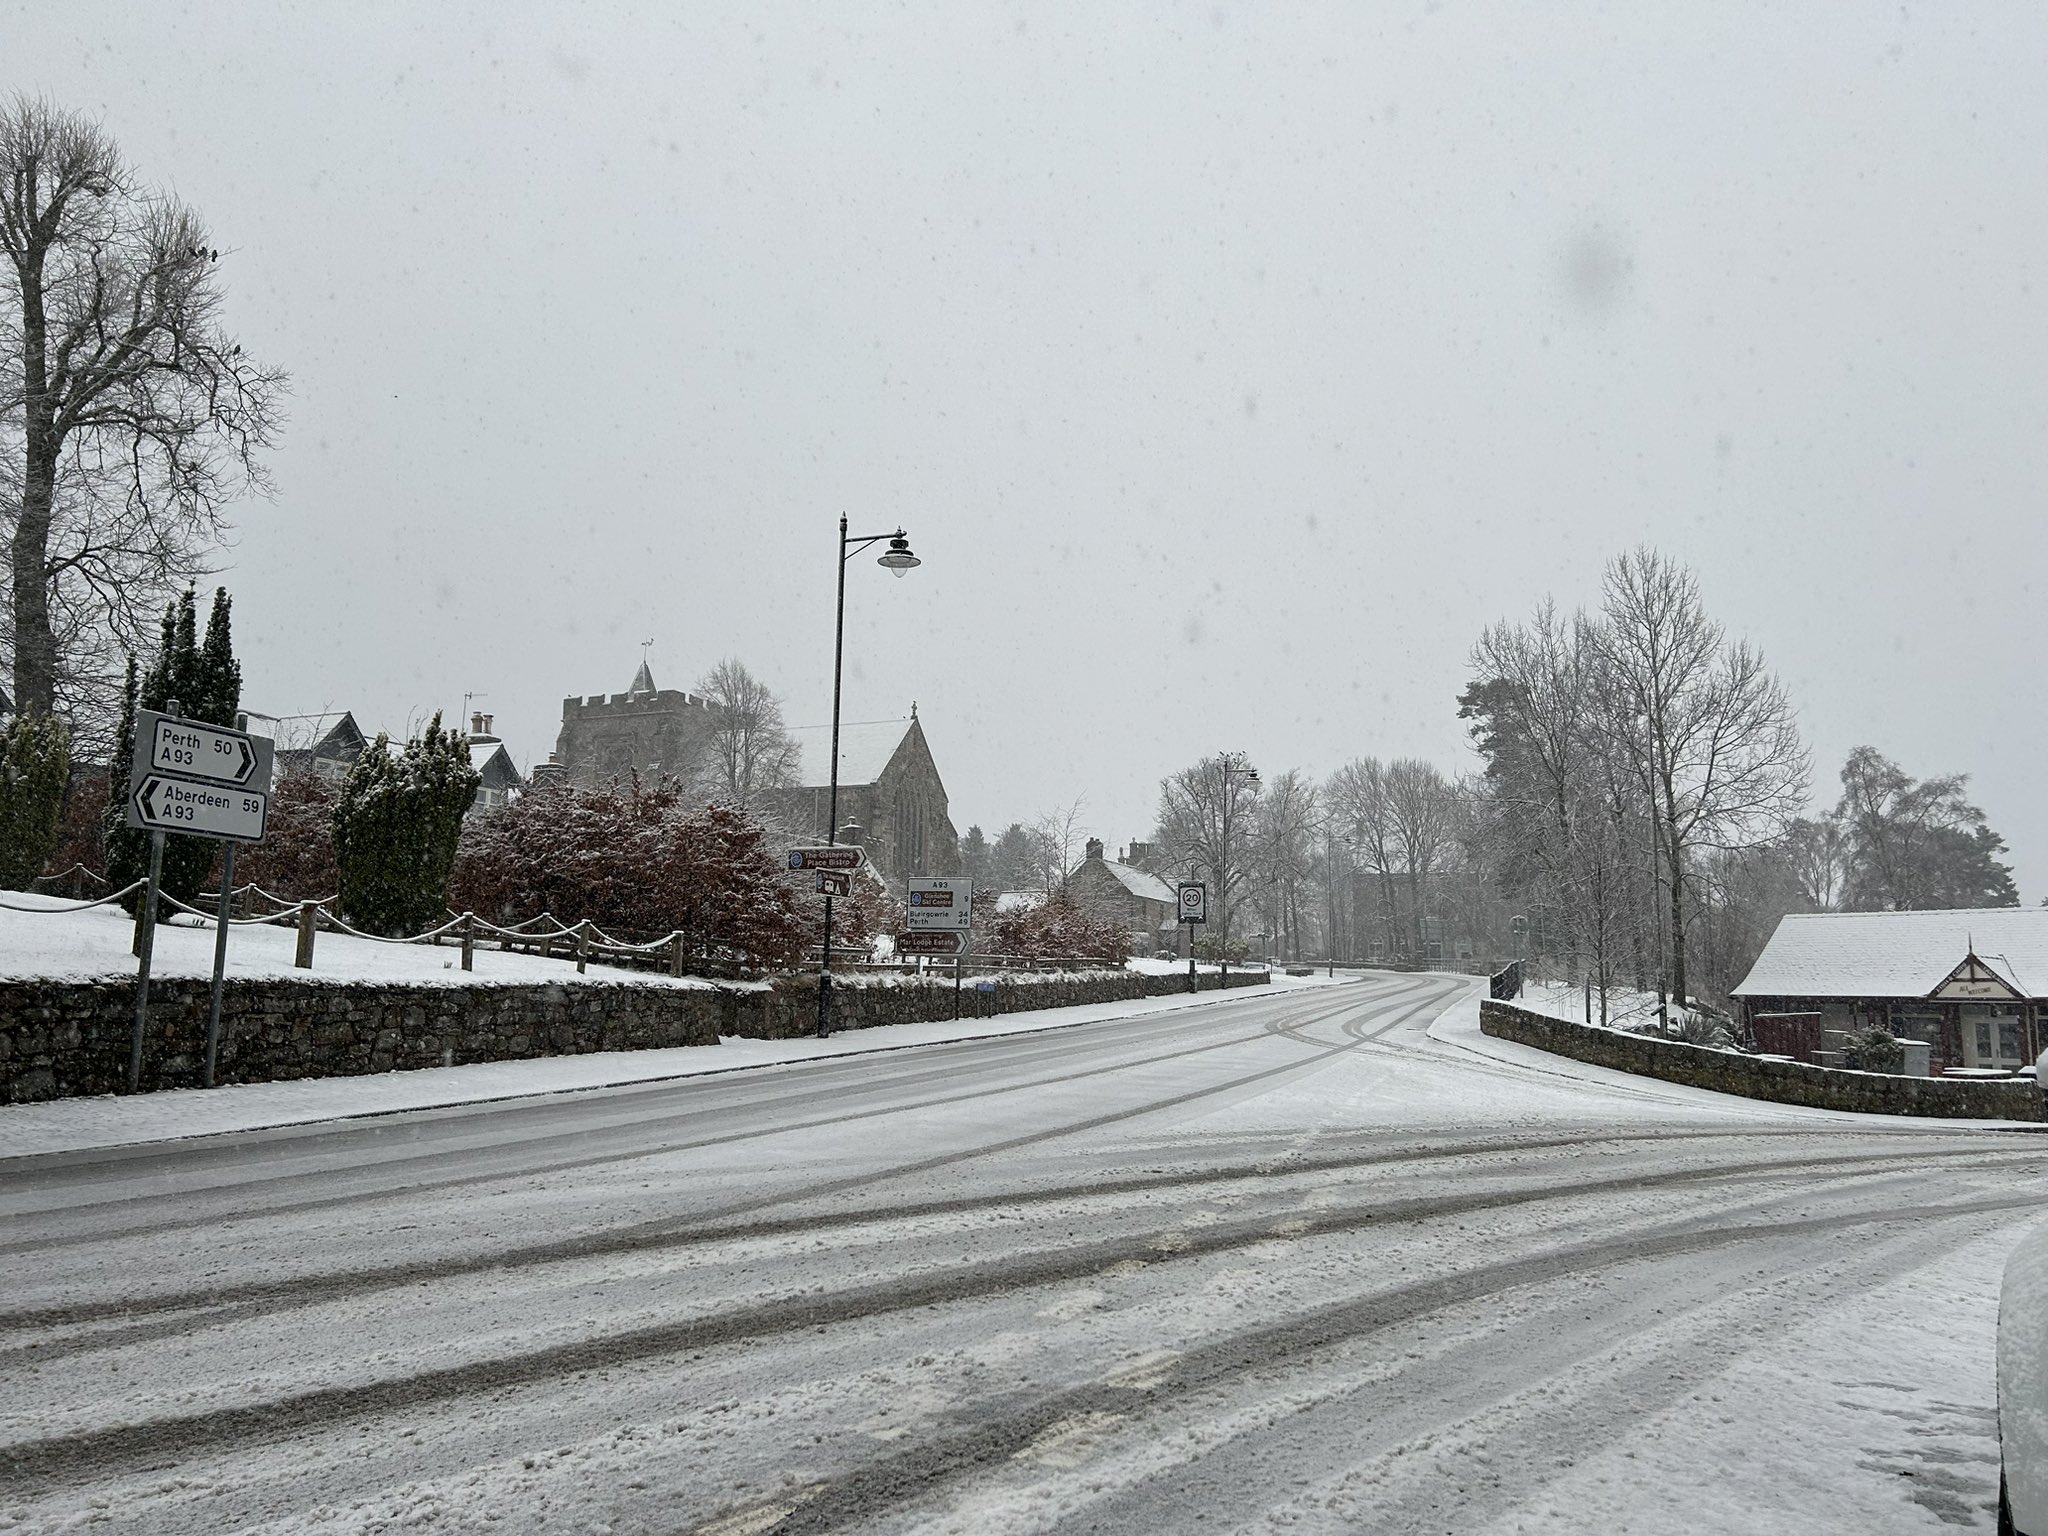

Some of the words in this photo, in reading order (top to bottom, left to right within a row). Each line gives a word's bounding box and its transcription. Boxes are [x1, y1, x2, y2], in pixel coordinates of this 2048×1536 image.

[162, 728, 201, 749] Perth
[214, 740, 233, 755] 50
[161, 747, 193, 765] A93
[164, 786, 230, 808] Aberdeen
[242, 799, 259, 813] 59
[162, 804, 194, 821] A93
[807, 859, 827, 867] Place
[819, 851, 854, 860] Gathering
[1186, 894, 1198, 902] 20
